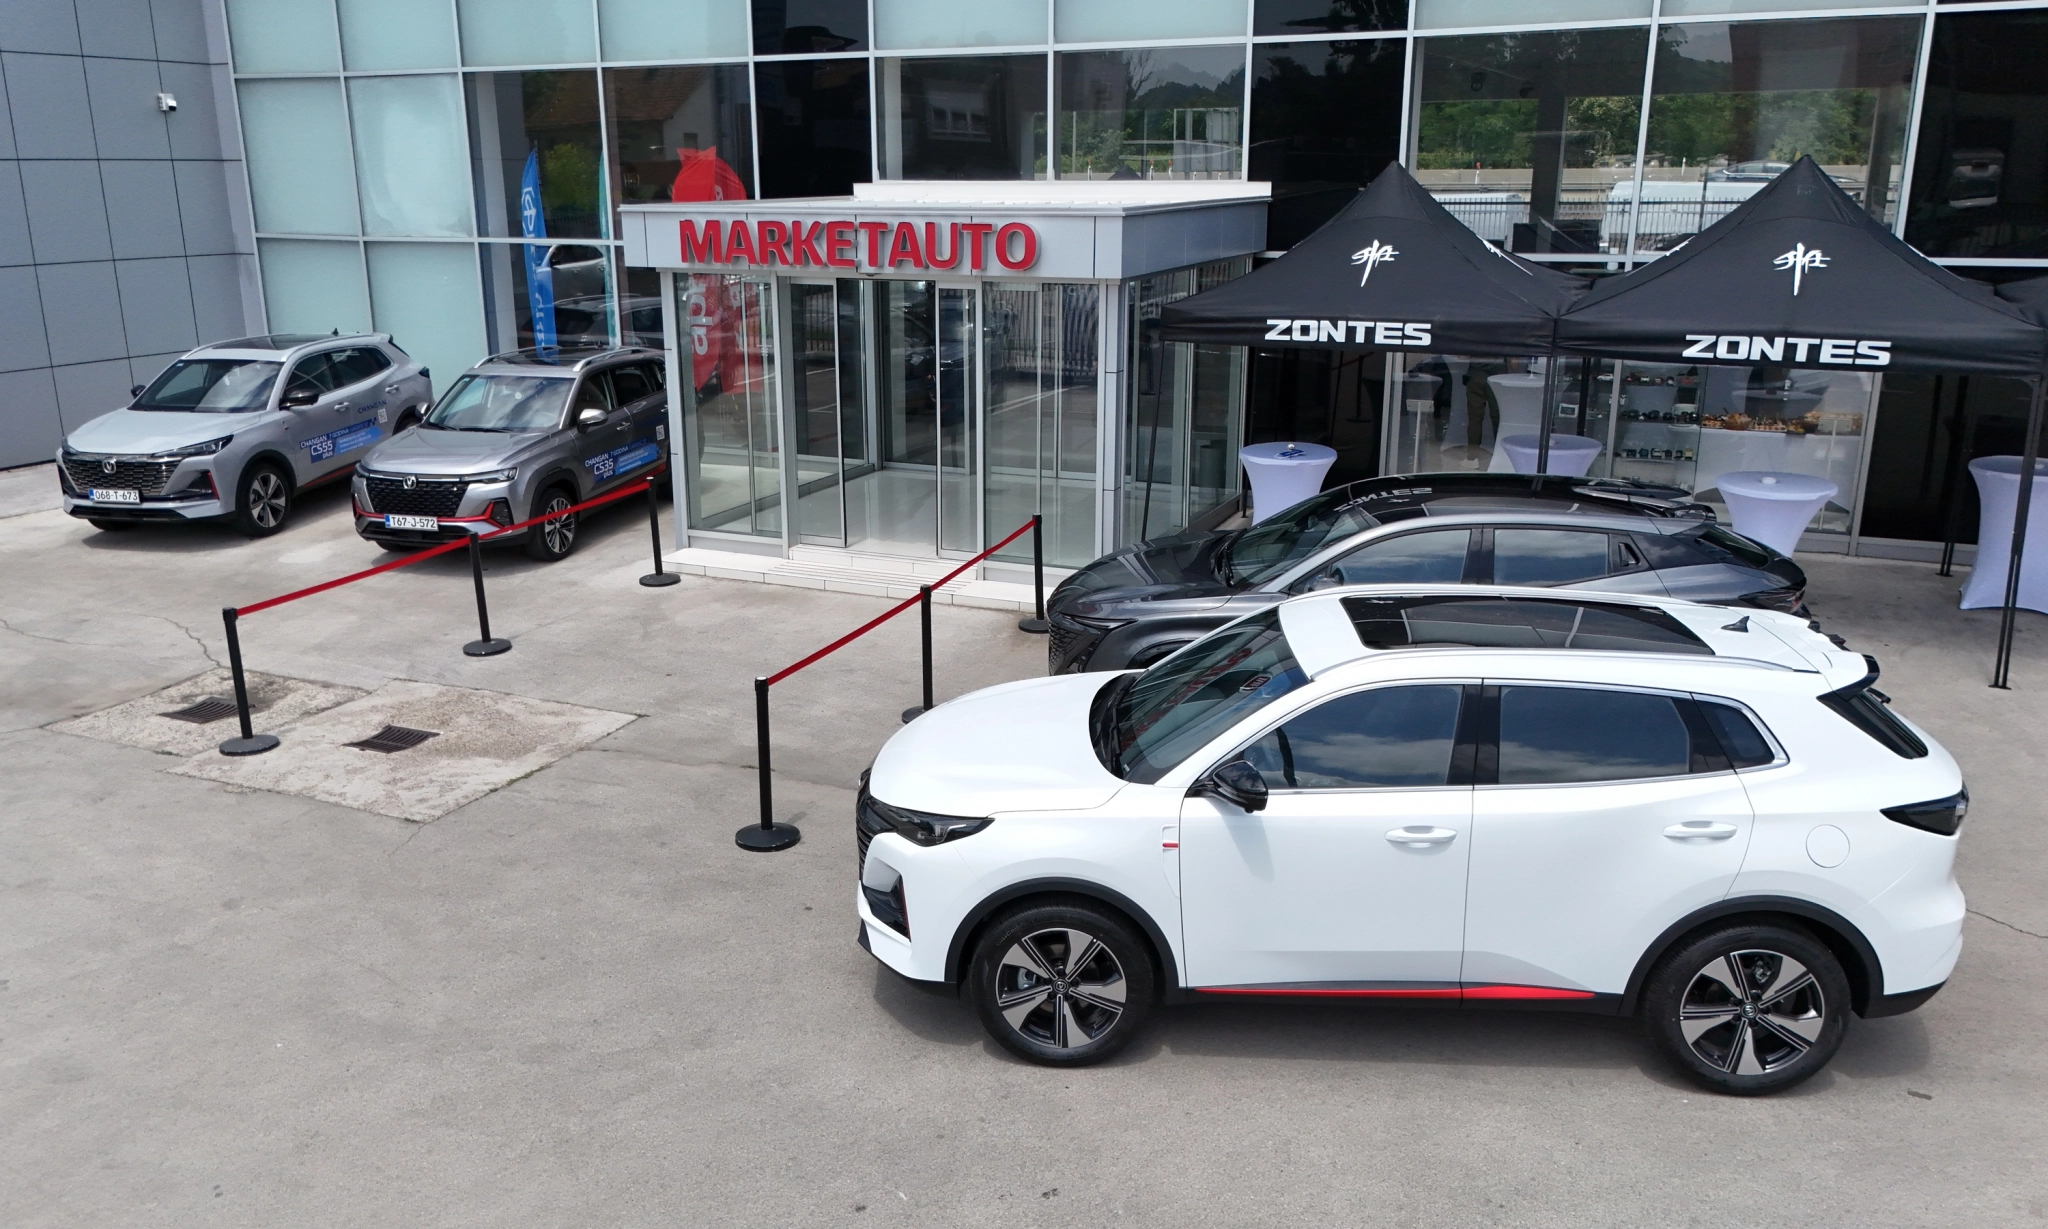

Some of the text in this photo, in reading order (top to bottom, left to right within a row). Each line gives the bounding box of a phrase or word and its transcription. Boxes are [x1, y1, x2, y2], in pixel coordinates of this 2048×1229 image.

[679, 219, 1039, 272] MARKETAUTO
[1264, 319, 1432, 346] ZONTES
[1682, 334, 1892, 366] ZONTES
[358, 400, 387, 414] CHANGAN
[301, 435, 327, 448] CHANGAN
[311, 440, 333, 456] CS55
[323, 451, 333, 459] plus
[585, 453, 609, 467] CHANGAN
[594, 459, 614, 475] CS35
[603, 470, 614, 478] plus
[95, 491, 138, 501] 068-T-673
[391, 516, 436, 529] T67-J-572
